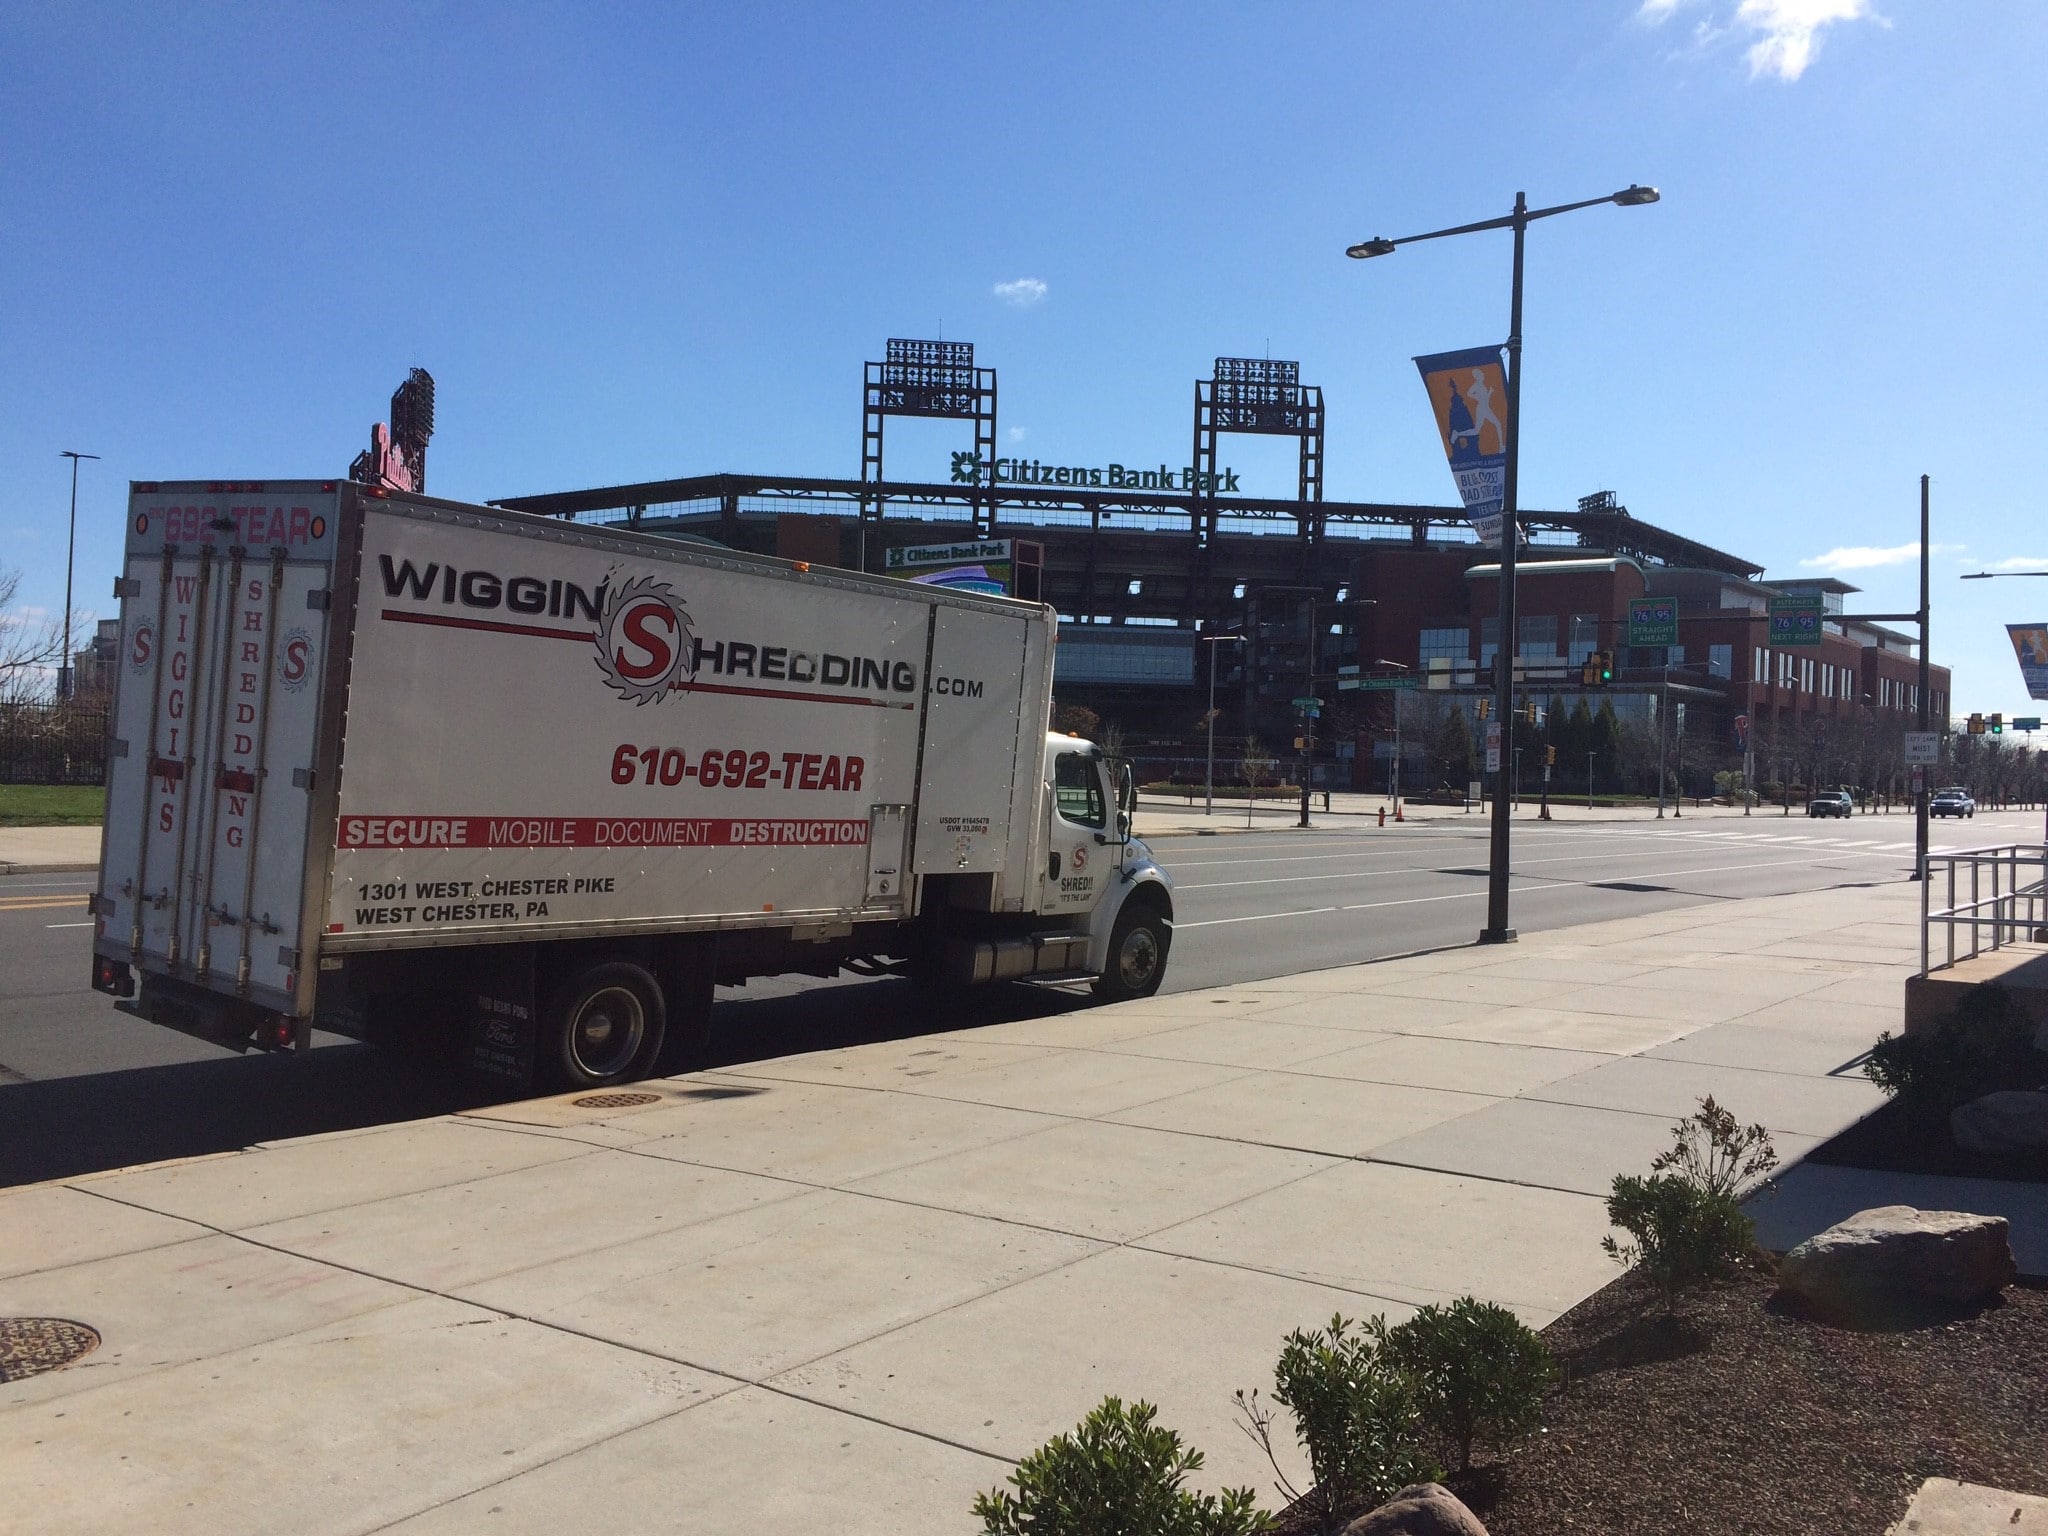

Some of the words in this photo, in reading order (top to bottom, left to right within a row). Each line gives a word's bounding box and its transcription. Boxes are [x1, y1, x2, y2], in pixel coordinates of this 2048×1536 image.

[992, 458, 1101, 487] Citizens
[1108, 464, 1174, 490] Bank
[1183, 467, 1240, 493] Park
[231, 507, 311, 546] TEAR
[907, 547, 950, 562] Citizens
[951, 544, 979, 559] Bank
[980, 542, 1005, 556] Park
[1636, 611, 1648, 620] 76
[1657, 610, 1670, 619] 95
[1777, 617, 1789, 628] 76
[1800, 617, 1814, 628] 95
[1632, 625, 1673, 634] STRAIGHT
[1639, 634, 1668, 642] AHEAD
[1795, 632, 1819, 640] RIGHT
[133, 627, 151, 664] S
[283, 641, 308, 681] S
[226, 580, 264, 848] SHREDDNG
[610, 743, 865, 792] 610-692-TEAR
[346, 820, 467, 845] SECURE
[488, 821, 577, 844] MOBILE
[594, 822, 713, 844] DOCUMENT
[729, 822, 867, 843] DESTRUCTION
[358, 883, 407, 901] 1301
[415, 881, 473, 899] WEST
[481, 878, 568, 897] CHESTER
[573, 877, 615, 894] PIKE
[1061, 876, 1094, 892] SHRED!!
[1071, 894, 1079, 902] THE
[355, 907, 416, 925] WEST
[422, 902, 519, 922] CHESTER,
[526, 901, 549, 918] PA
[486, 1022, 516, 1044] Ford
